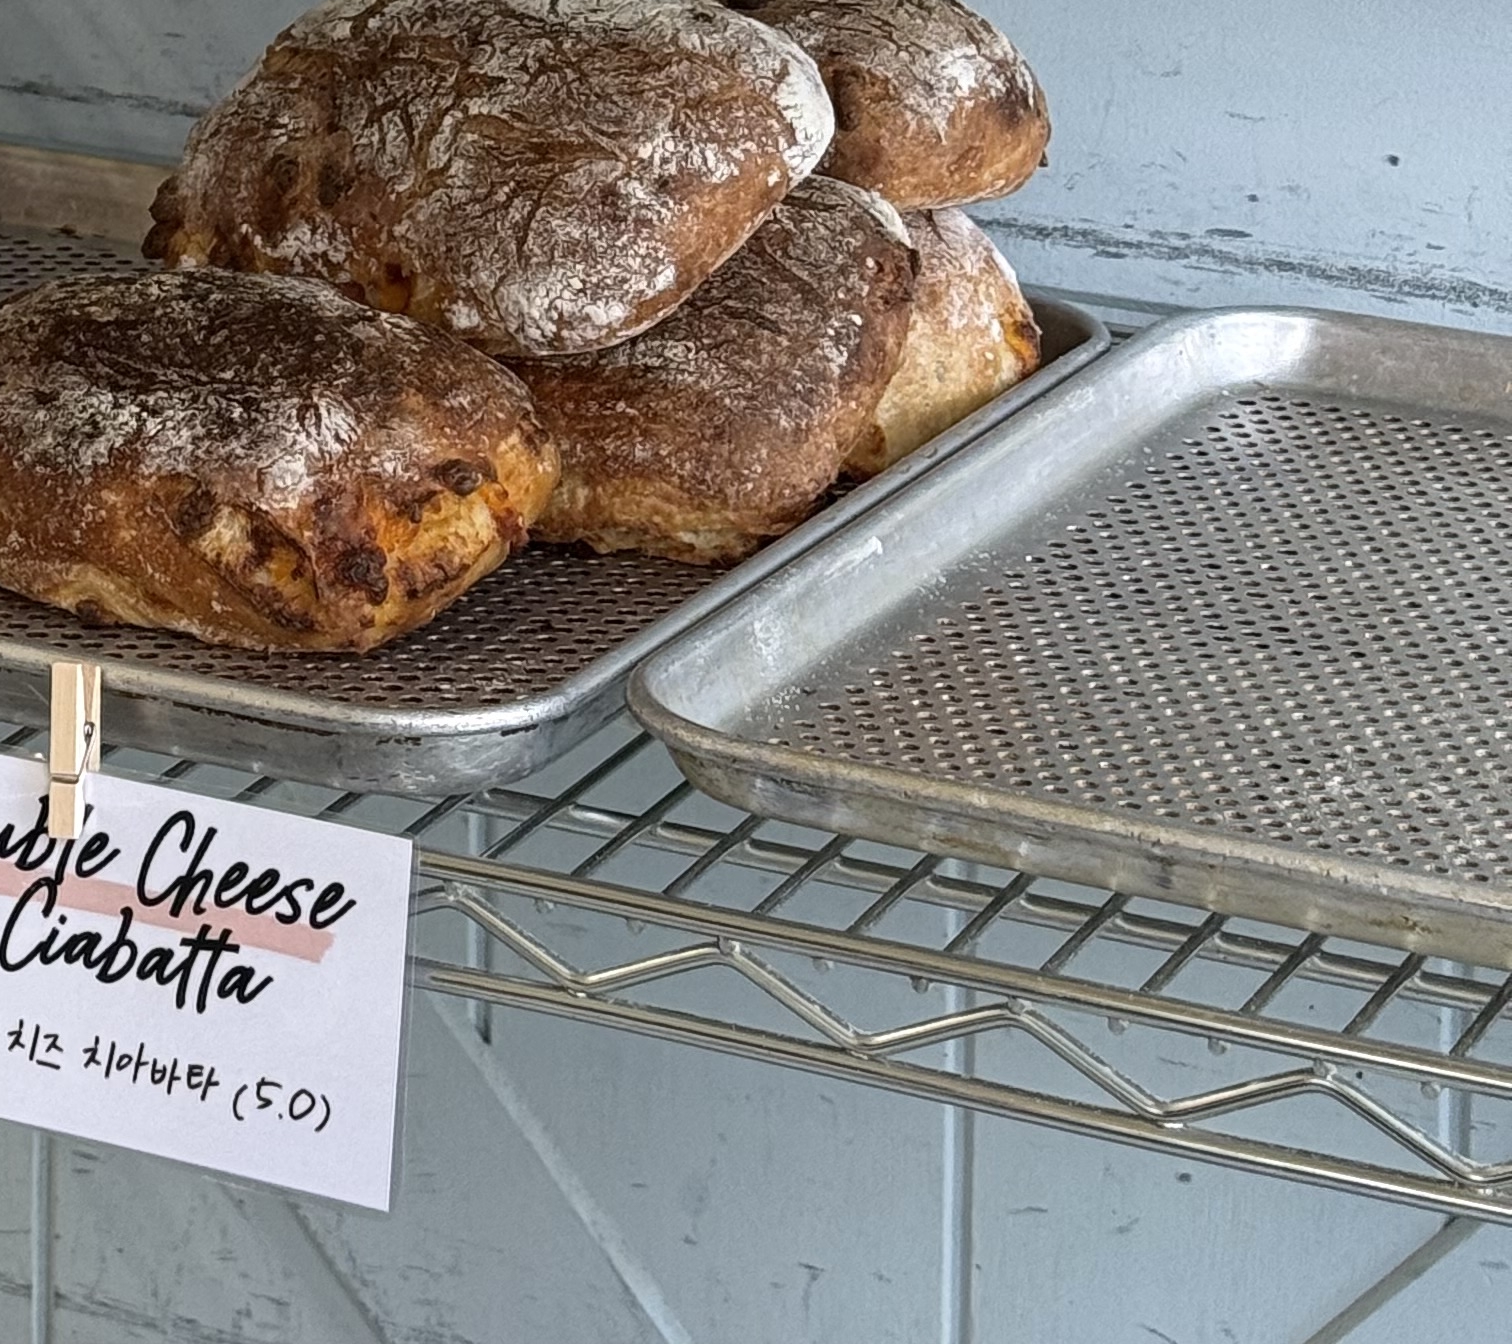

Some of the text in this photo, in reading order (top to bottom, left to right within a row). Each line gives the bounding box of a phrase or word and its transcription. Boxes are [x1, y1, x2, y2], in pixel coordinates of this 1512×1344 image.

[136, 810, 357, 930] Cheese
[7, 1019, 65, 1071] 치즈
[83, 1036, 220, 1102] 치아바타
[231, 1076, 332, 1133] (5.0)
